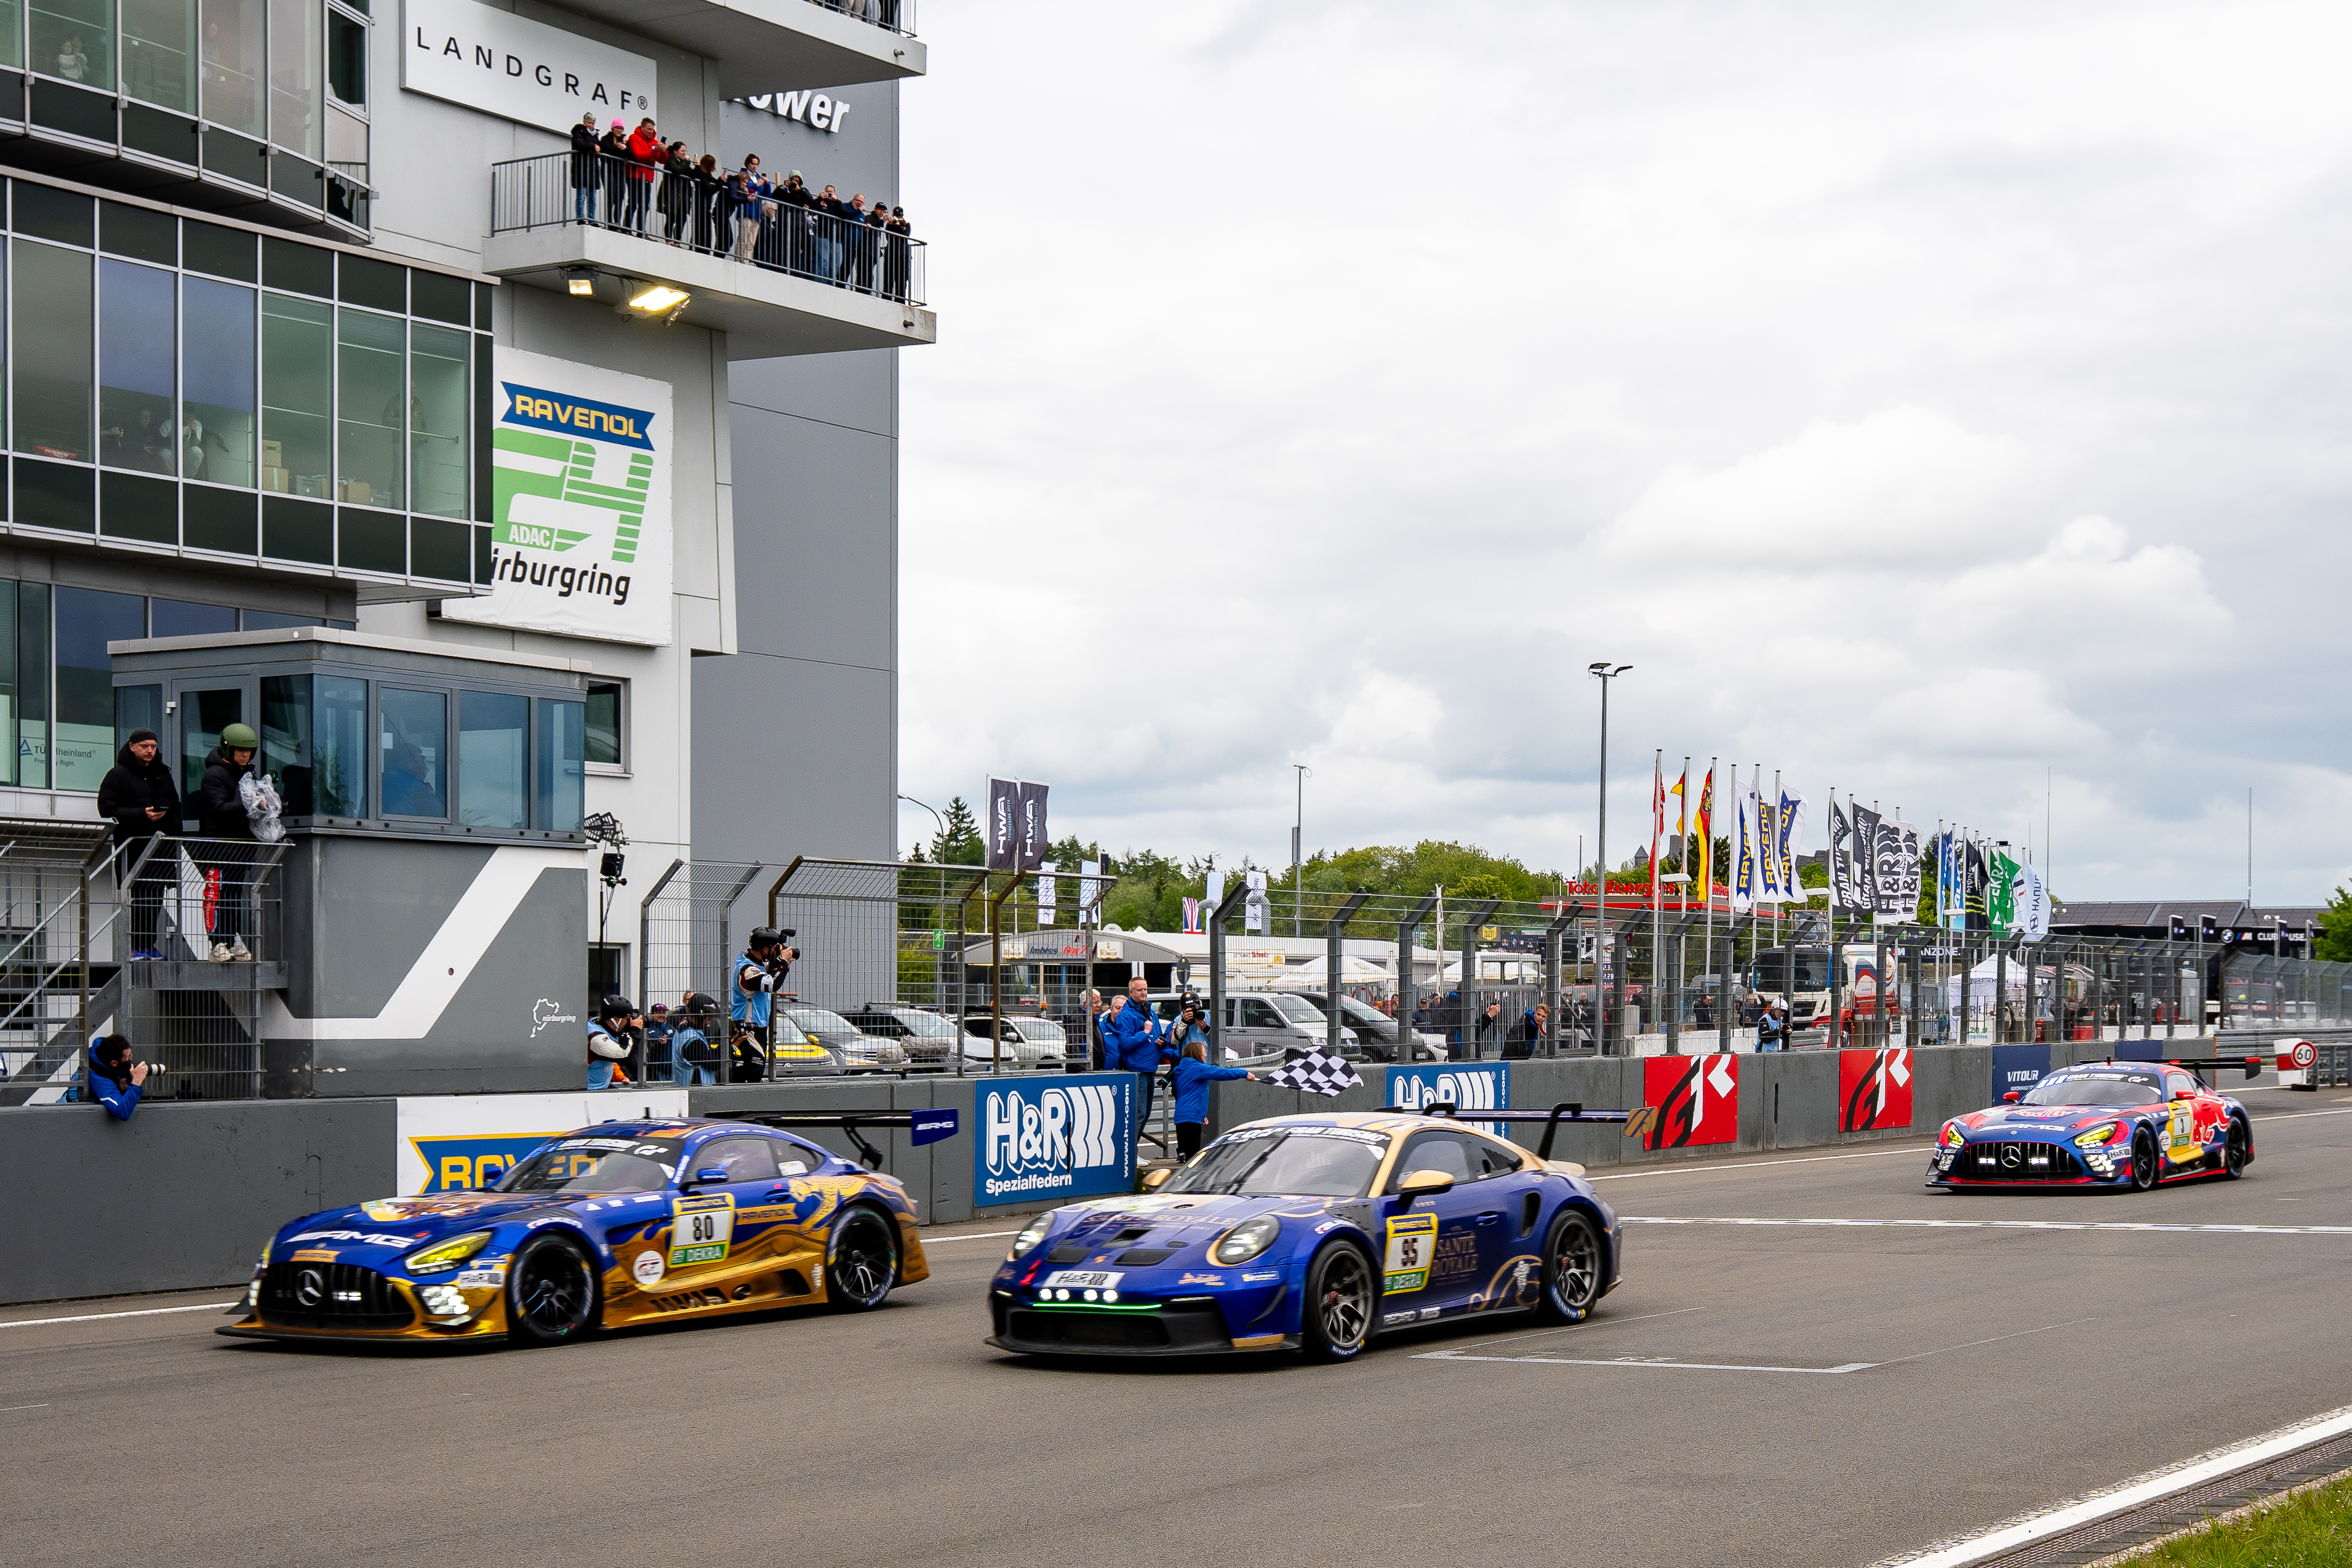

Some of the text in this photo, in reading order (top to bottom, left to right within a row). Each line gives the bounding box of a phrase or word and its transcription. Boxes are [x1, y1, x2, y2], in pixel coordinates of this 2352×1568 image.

[515, 394, 643, 439] RAVENOL
[508, 524, 551, 548] ADAC
[33, 744, 45, 754] TÜ
[997, 796, 1007, 854] HWA
[1025, 799, 1034, 857] HWA
[1877, 859, 1901, 915] H&R
[2256, 932, 2307, 941] CLUBUSE.
[542, 1014, 576, 1023] nürburgring
[2297, 1048, 2312, 1060] 60
[2007, 1070, 2039, 1082] VITOUR
[922, 1121, 954, 1131] AMG
[986, 1088, 1073, 1176] H&R
[1998, 1123, 2066, 1132] AMG
[986, 1173, 1072, 1196] Spezialfedern
[692, 1214, 715, 1242] 80
[306, 1230, 416, 1248] AMG
[687, 1246, 722, 1263] DEKRA
[1430, 1254, 1479, 1277] ROYALE
